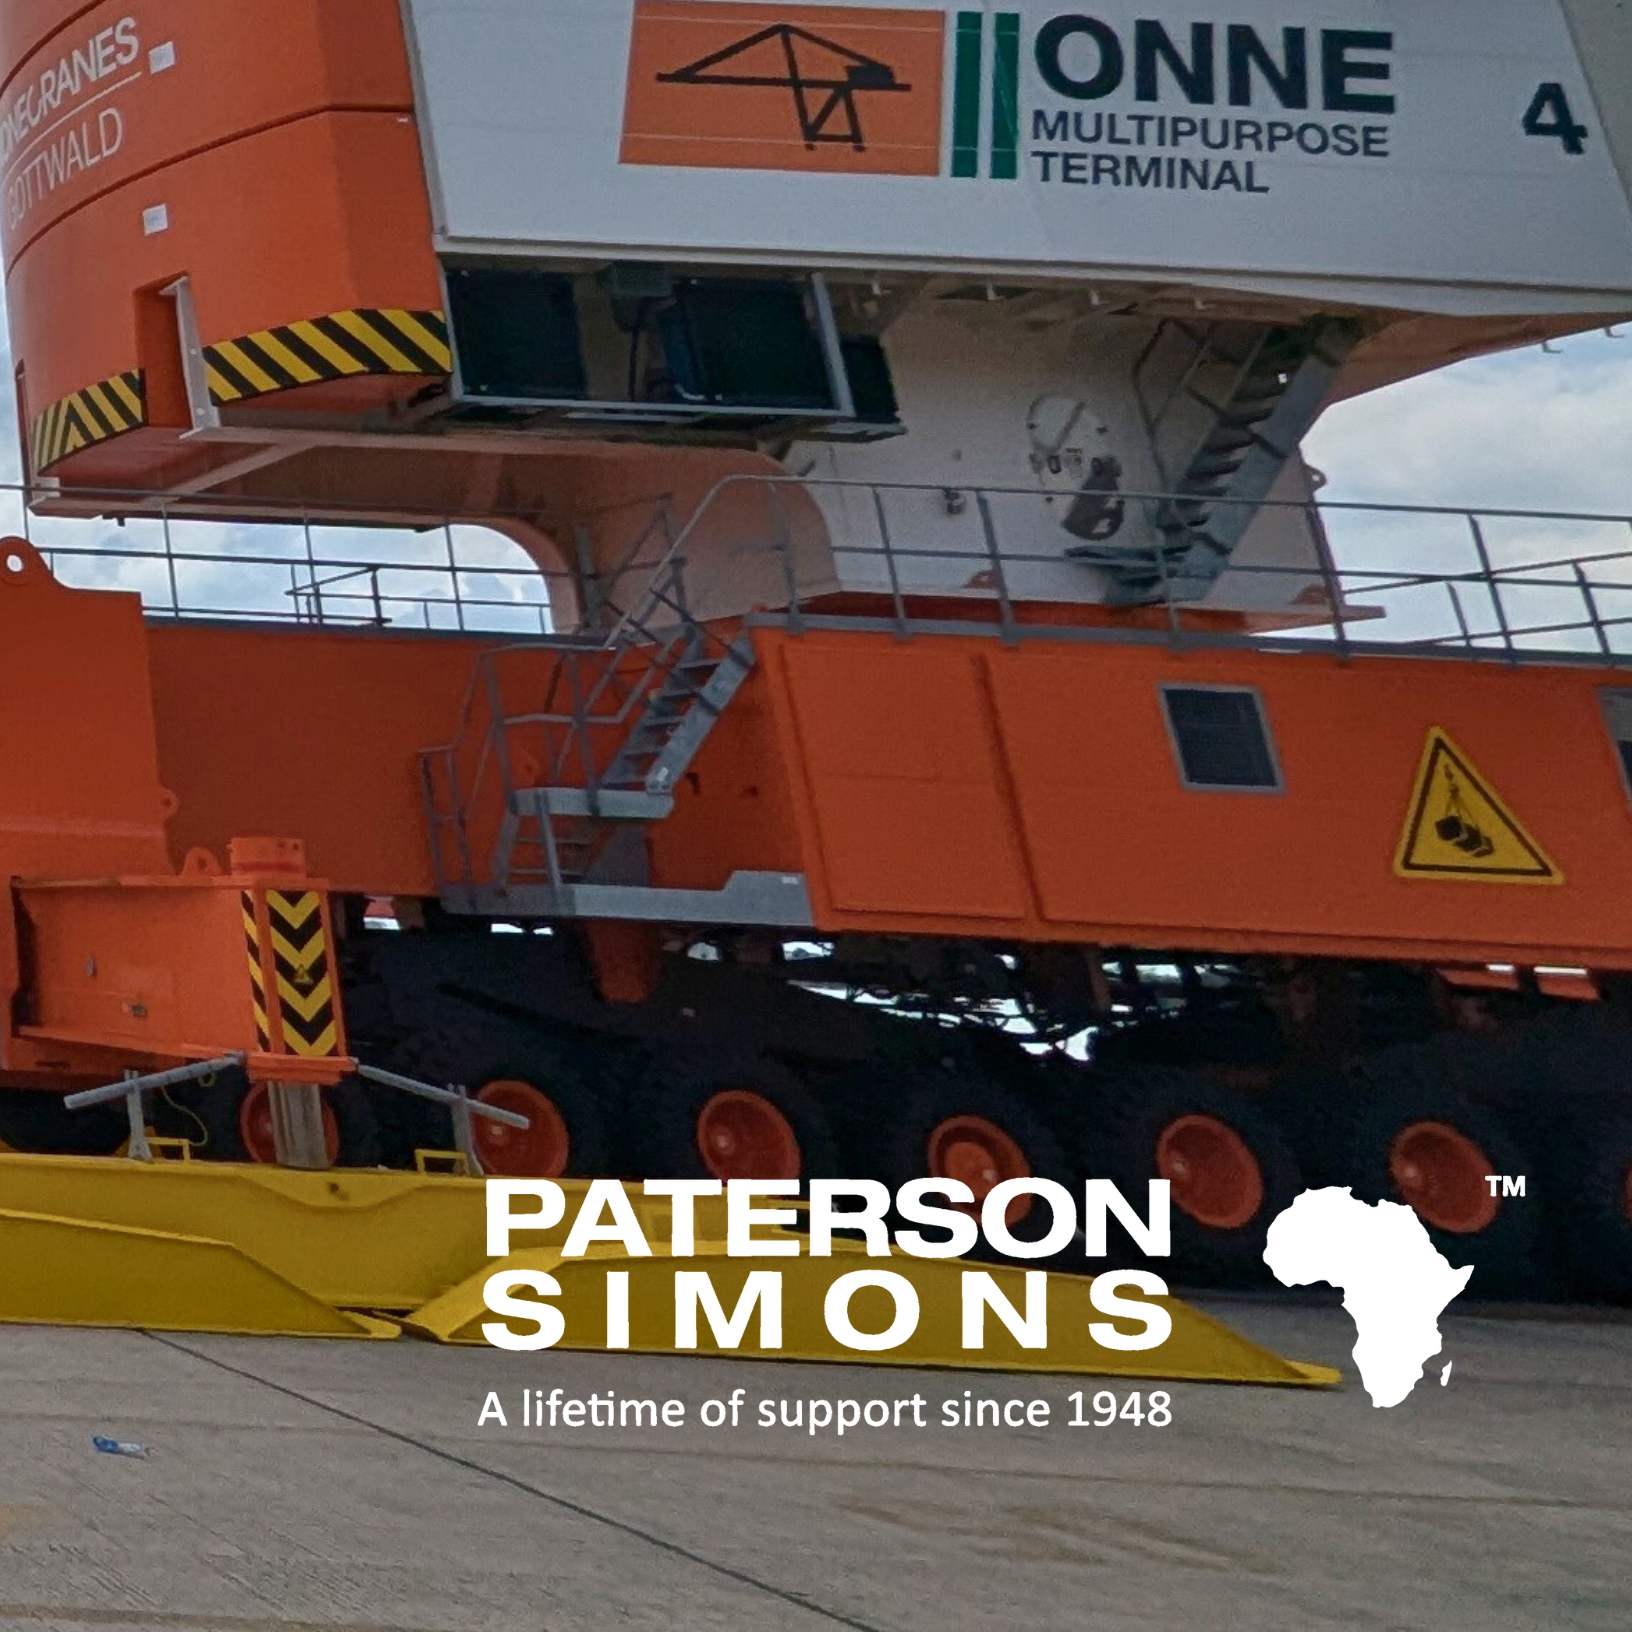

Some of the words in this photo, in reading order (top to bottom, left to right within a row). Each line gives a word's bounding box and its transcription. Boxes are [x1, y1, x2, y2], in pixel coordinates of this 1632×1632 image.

[1034, 13, 1396, 114] ONNE
[1031, 109, 1391, 158] MULTIPURPOSE
[1521, 81, 1589, 156] 4
[1031, 151, 1270, 194] TERMINAL
